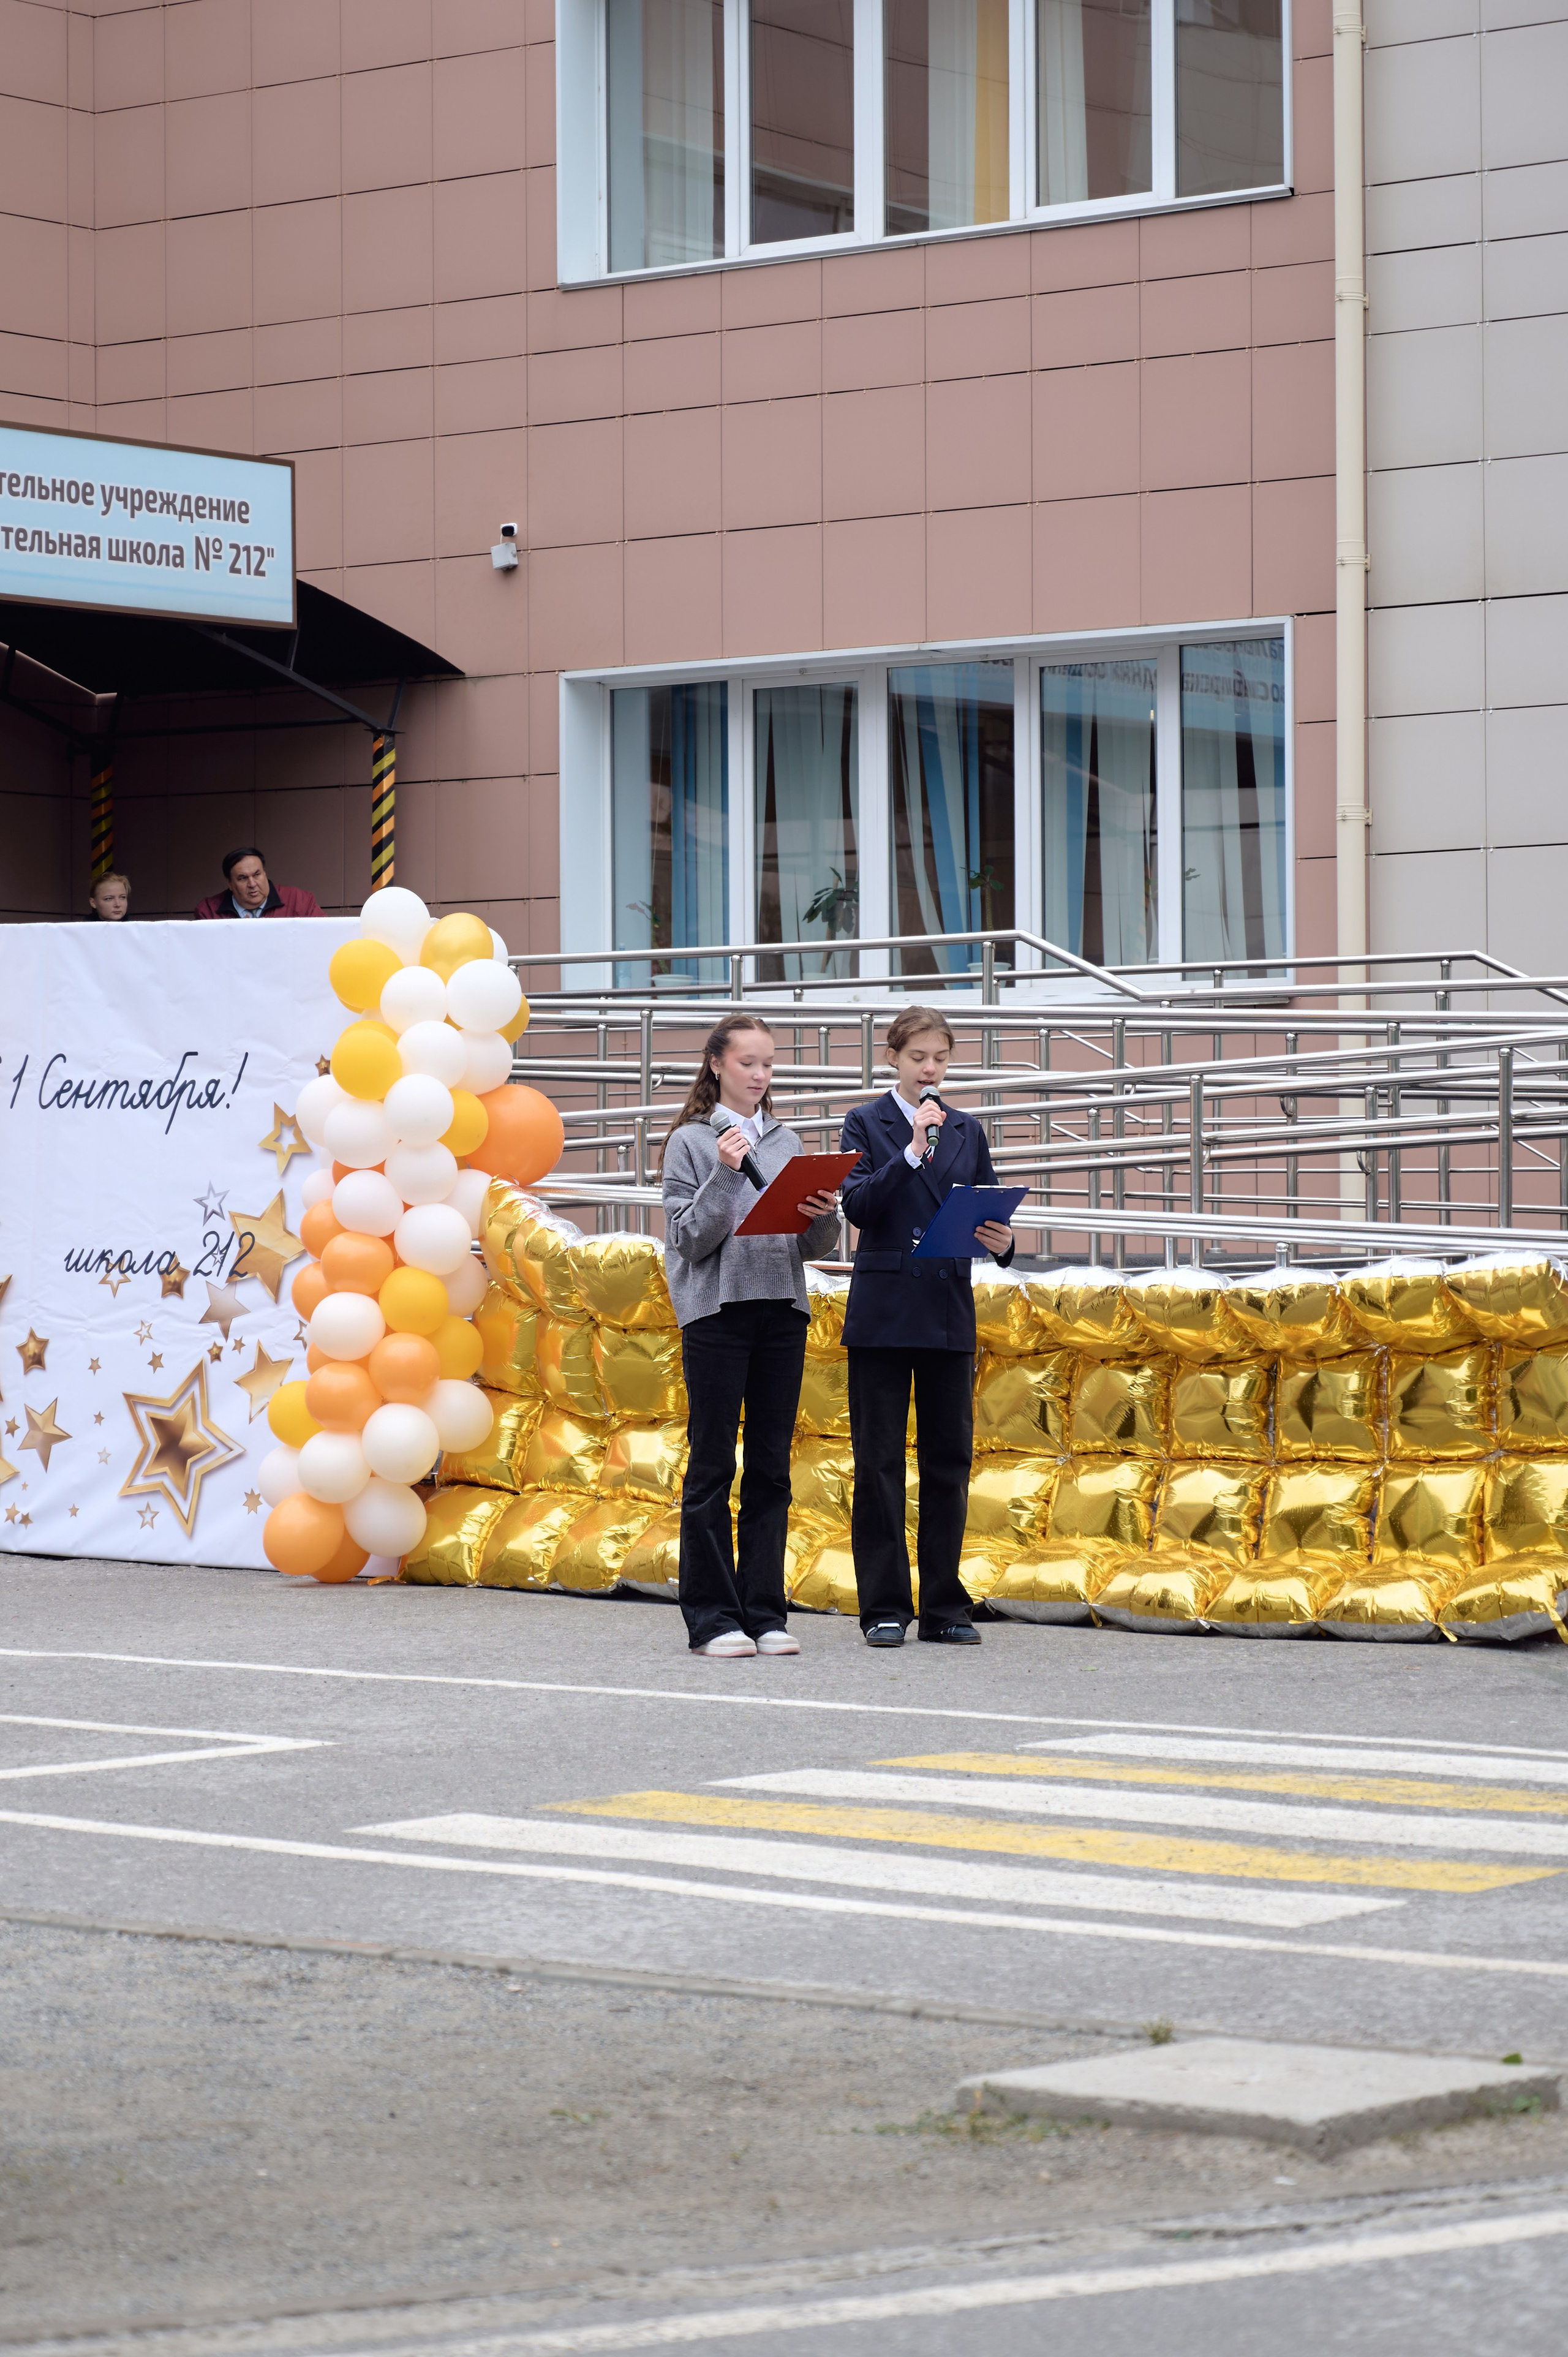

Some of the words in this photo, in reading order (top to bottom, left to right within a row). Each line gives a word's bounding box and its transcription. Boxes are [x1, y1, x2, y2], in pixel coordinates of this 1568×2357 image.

[100, 484, 250, 524] учреждение
[108, 538, 184, 568] школа
[194, 535, 223, 571] №
[228, 543, 274, 577] 212"
[39, 1051, 249, 1135] Сентября!
[63, 1247, 181, 1275] школа
[192, 1231, 255, 1278] 212
